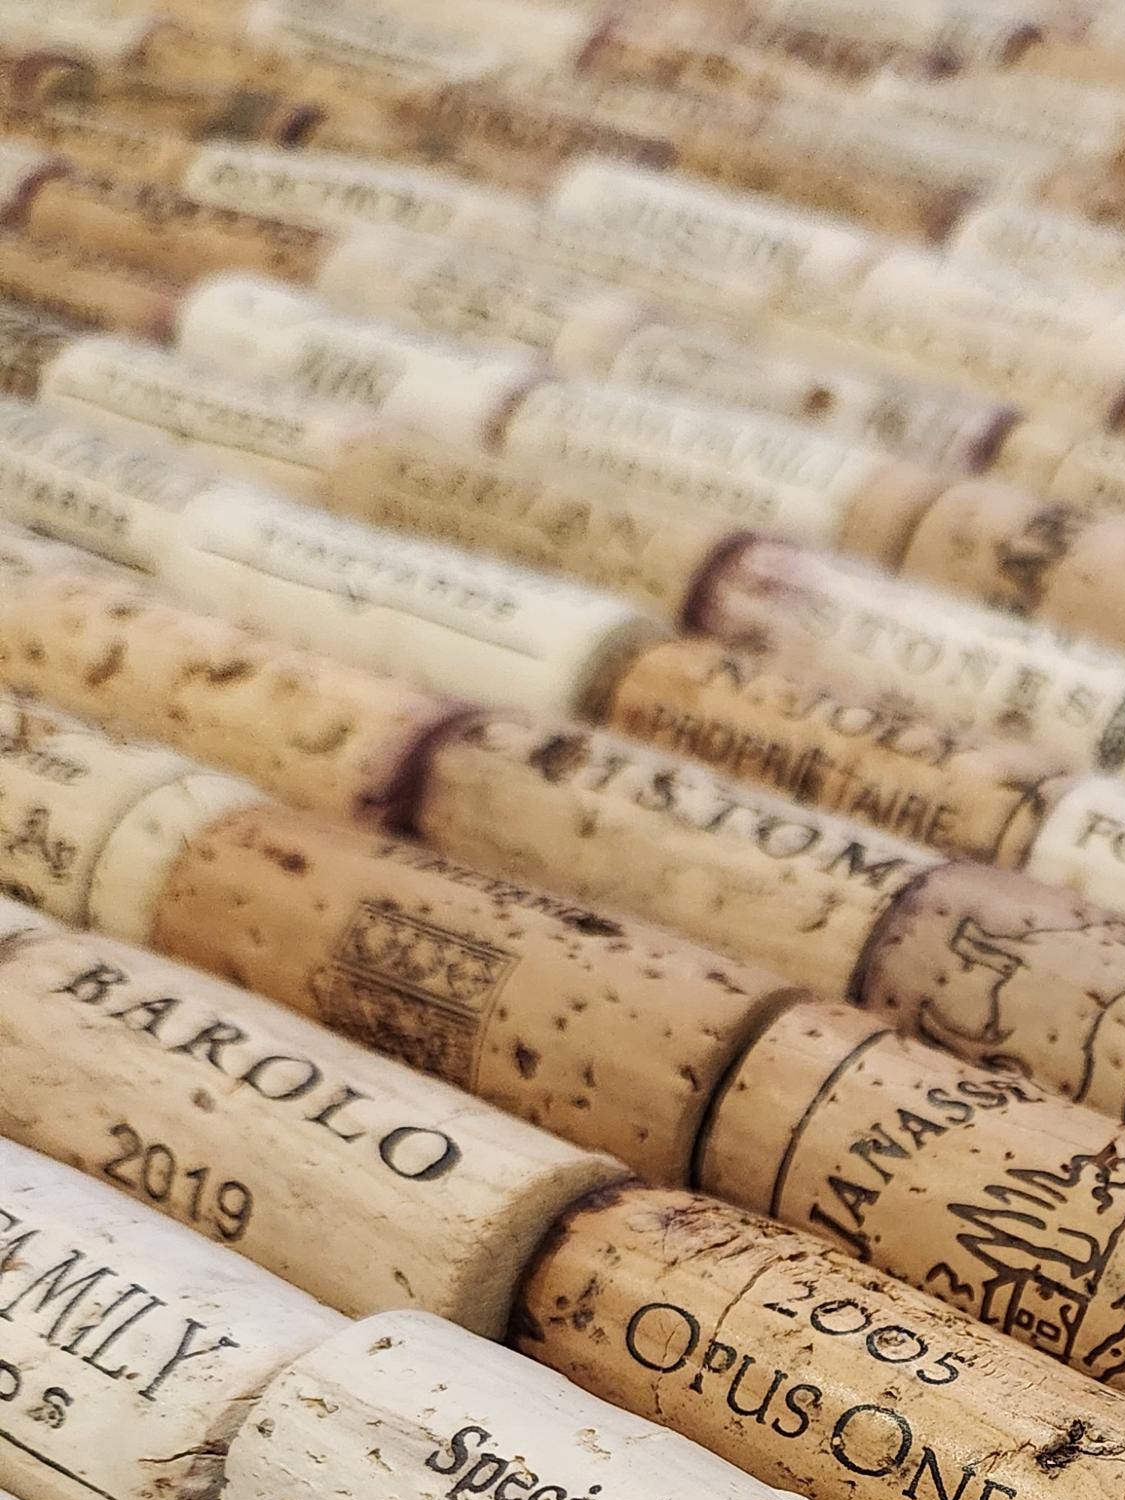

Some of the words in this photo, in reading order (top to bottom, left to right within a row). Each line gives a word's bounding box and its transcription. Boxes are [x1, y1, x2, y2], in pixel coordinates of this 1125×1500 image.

[49, 962, 463, 1182] BAROLO
[101, 1121, 254, 1243] 2019
[625, 1302, 824, 1440] OPUS
[763, 1280, 972, 1386] 2005
